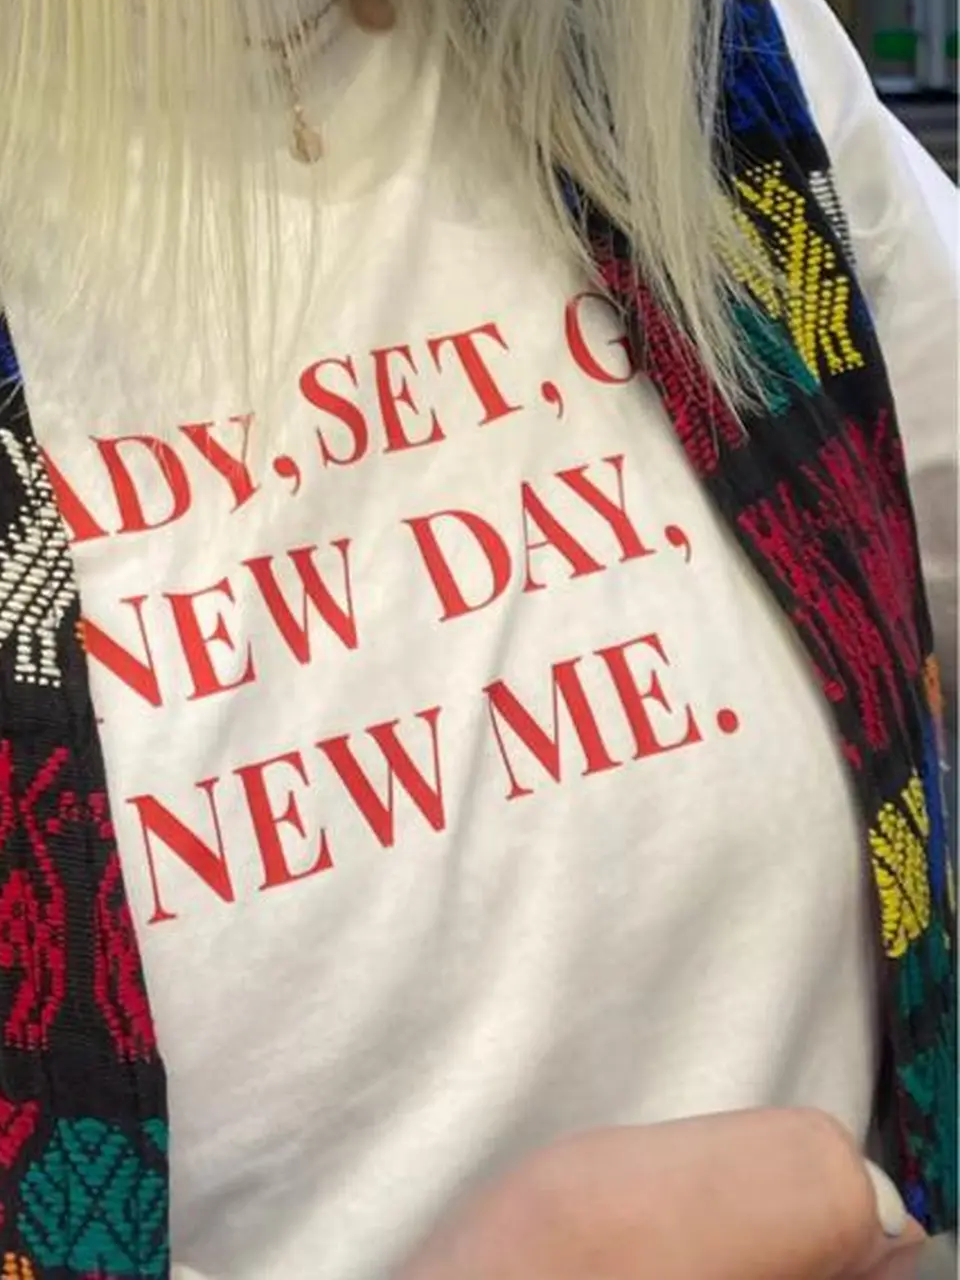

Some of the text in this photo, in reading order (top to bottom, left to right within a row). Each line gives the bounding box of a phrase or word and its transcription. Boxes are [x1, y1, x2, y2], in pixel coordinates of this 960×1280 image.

[298, 322, 565, 468] SET,
[76, 455, 694, 710] NEW DAY,
[125, 632, 741, 926] NEW ME.
